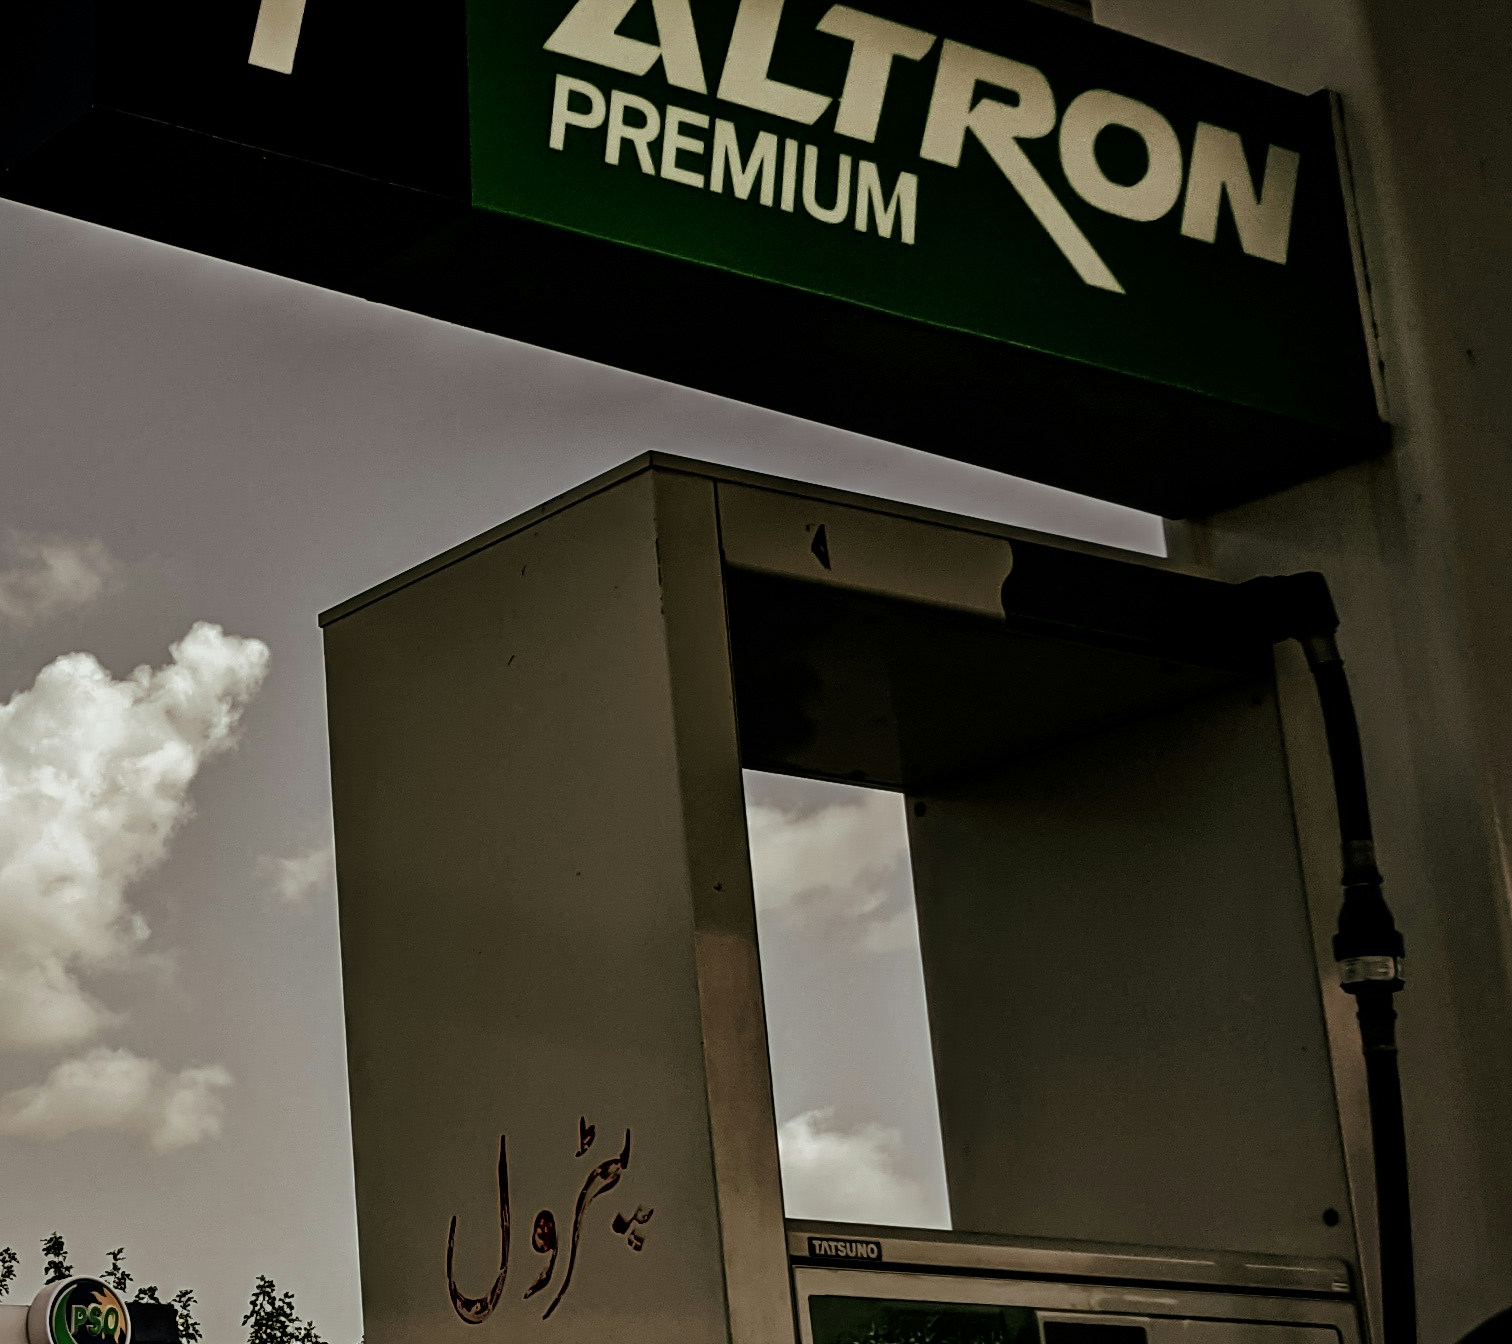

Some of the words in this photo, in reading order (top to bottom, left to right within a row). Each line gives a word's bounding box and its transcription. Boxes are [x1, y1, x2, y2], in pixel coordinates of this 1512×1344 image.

[548, 73, 920, 247] PREMIUM
[811, 1239, 878, 1259] TATSUNO
[70, 1304, 119, 1337] PSO
